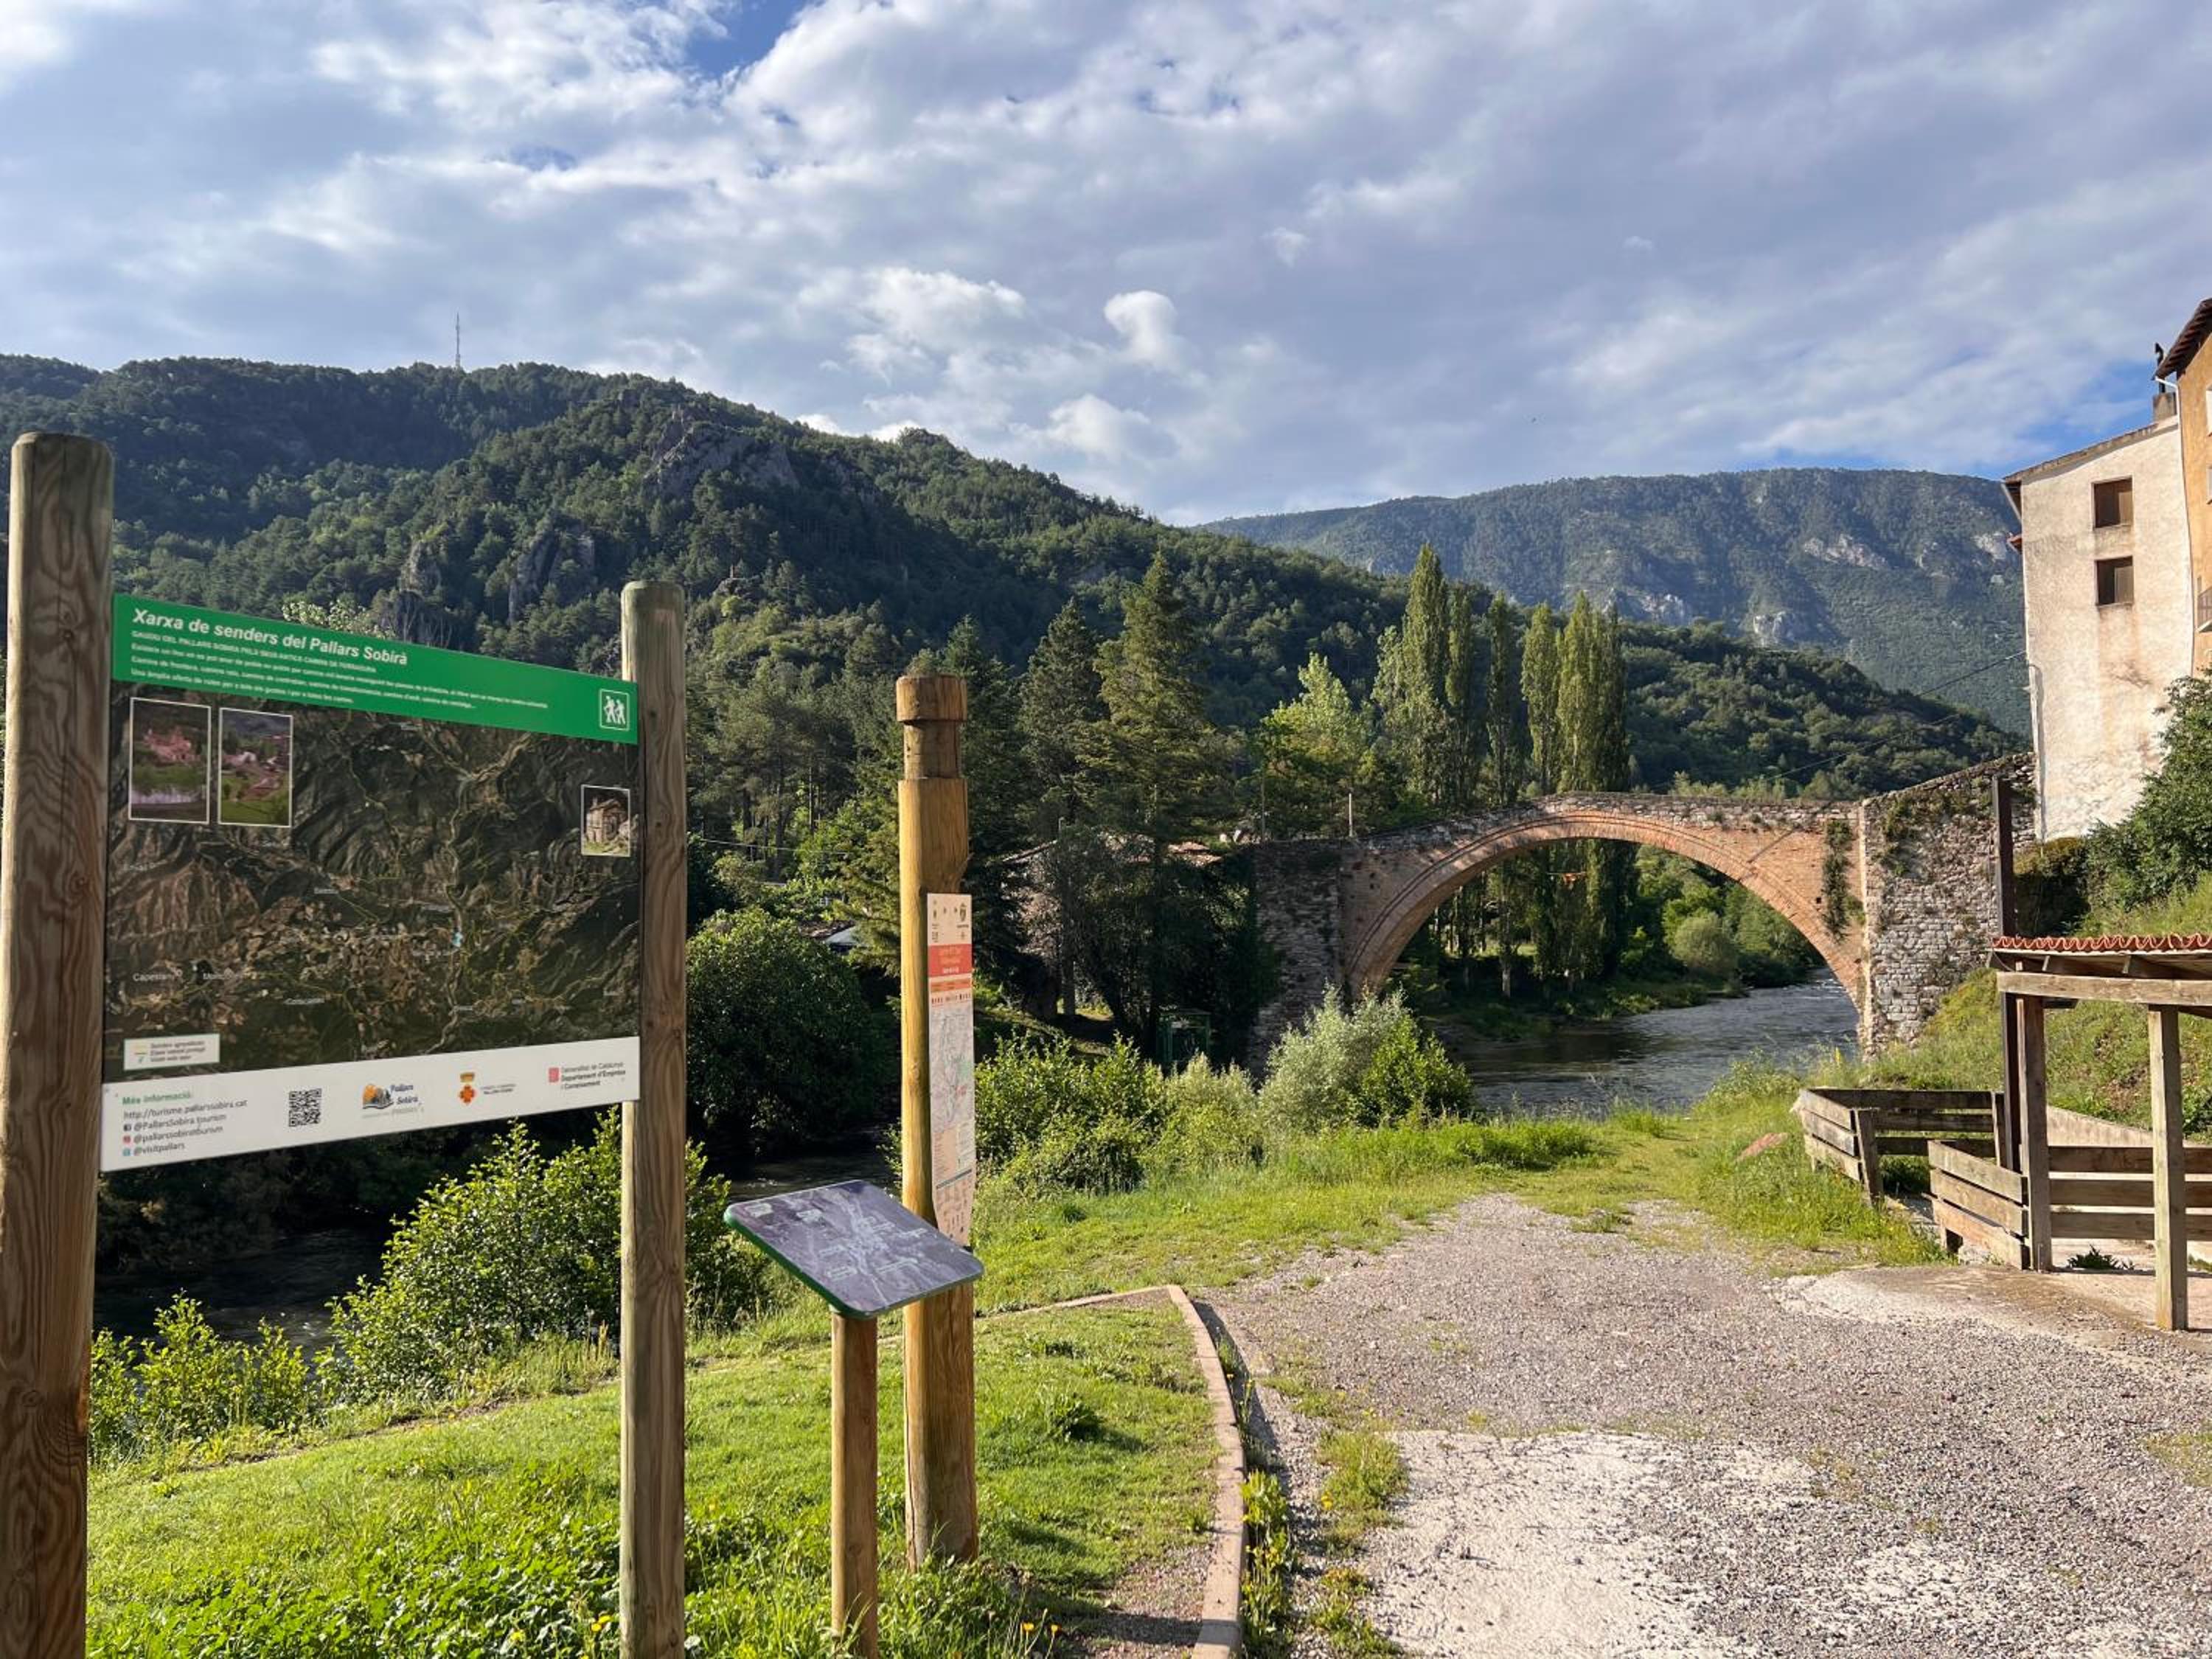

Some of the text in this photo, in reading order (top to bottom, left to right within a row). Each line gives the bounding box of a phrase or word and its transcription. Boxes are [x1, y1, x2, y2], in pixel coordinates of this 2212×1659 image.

[133, 608, 184, 630] Xarxa
[188, 619, 210, 633] de
[213, 625, 278, 645] senders
[282, 633, 307, 650] del
[310, 637, 360, 658] Pallars
[364, 646, 408, 666] Sobirà
